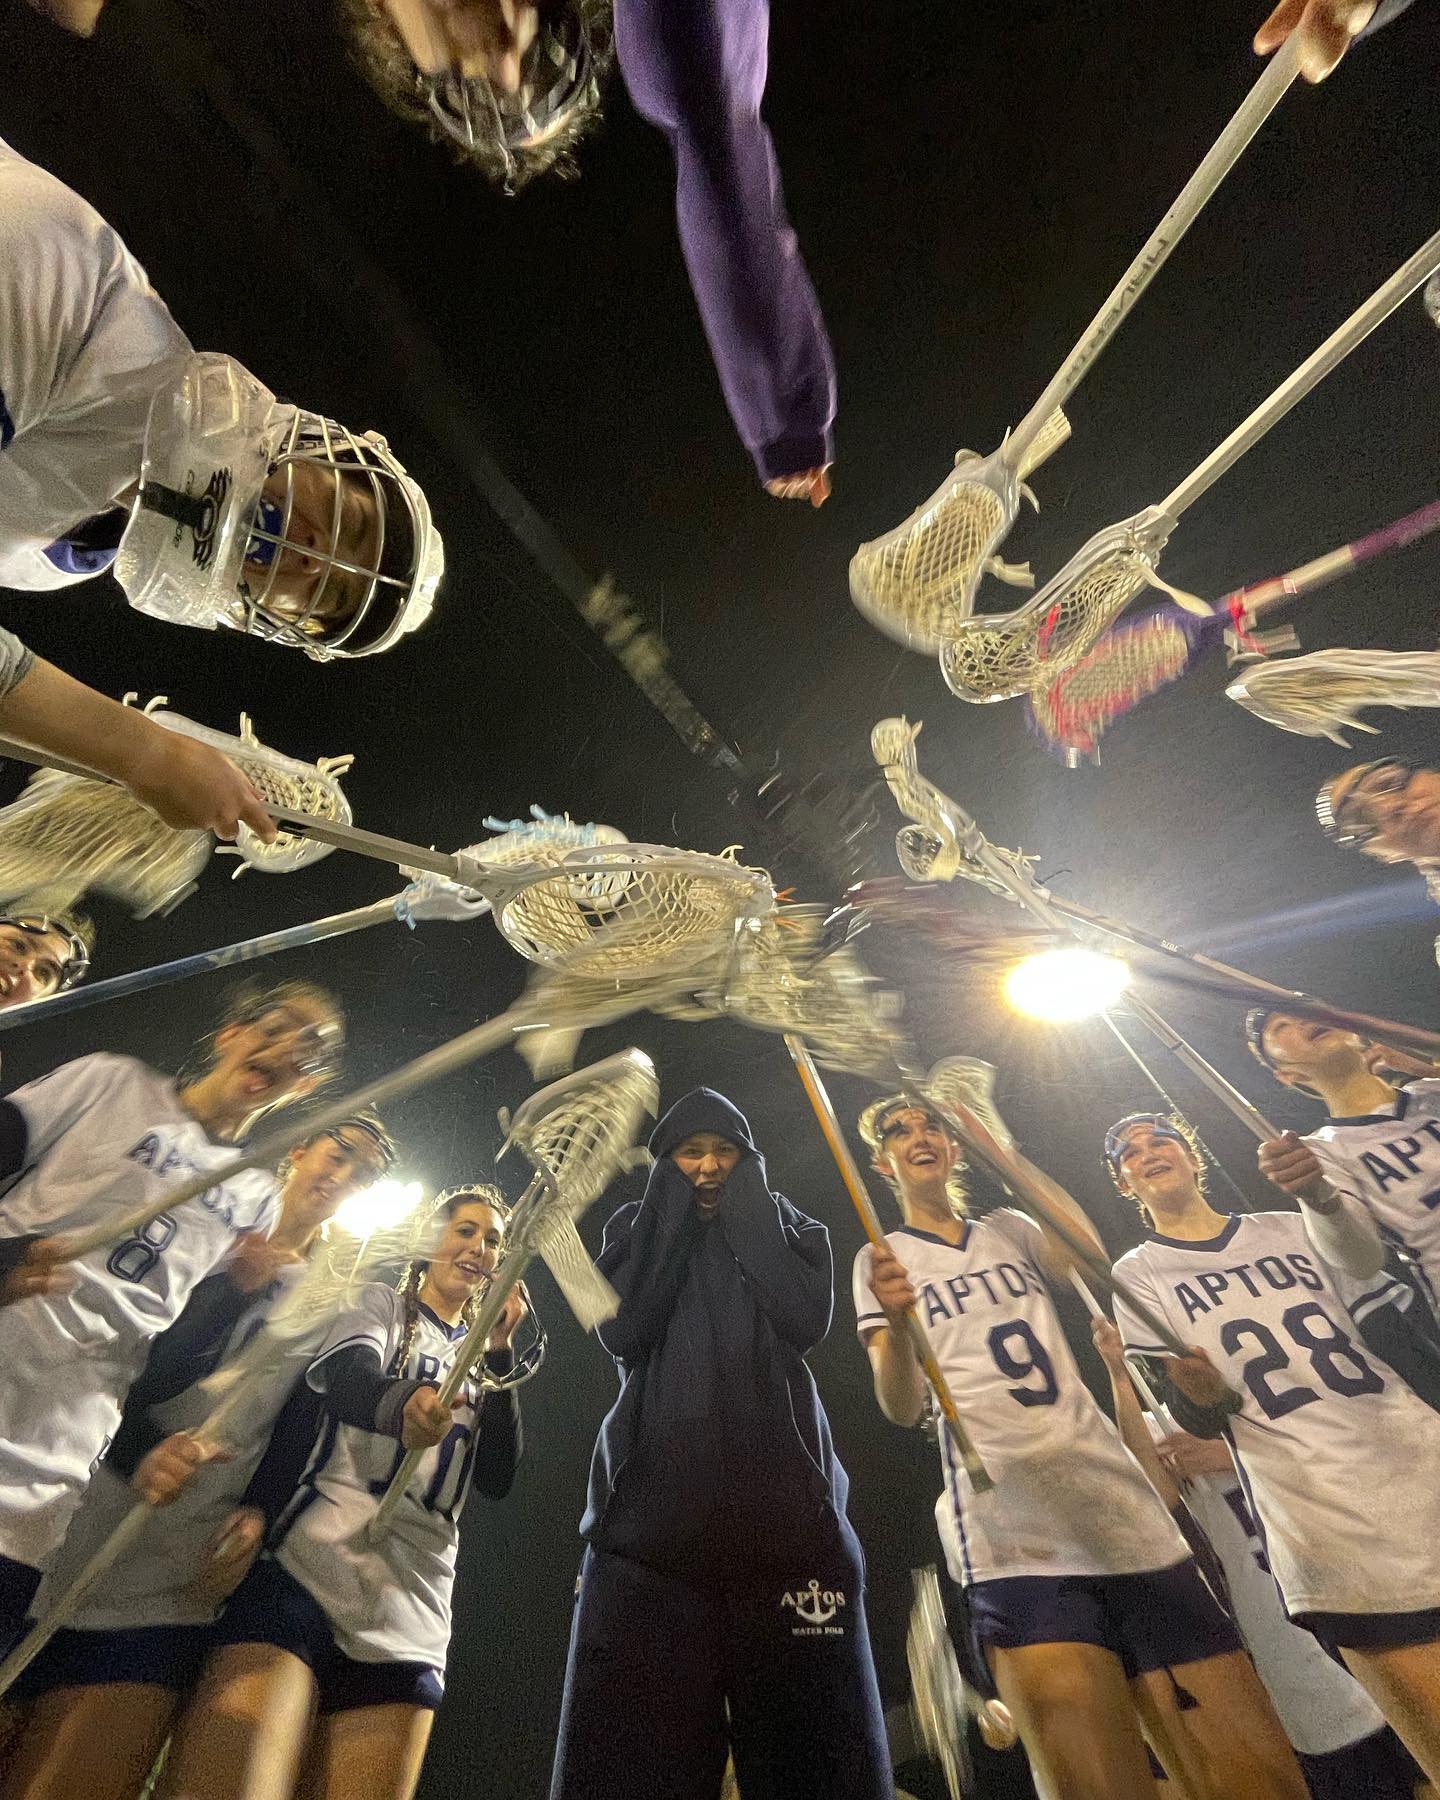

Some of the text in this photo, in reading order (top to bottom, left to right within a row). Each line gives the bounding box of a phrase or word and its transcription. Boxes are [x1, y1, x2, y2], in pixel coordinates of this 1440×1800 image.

[106, 1212, 177, 1283] 8
[922, 1262, 1045, 1328] APTOS
[1174, 1253, 1323, 1325] APTOS
[987, 1318, 1058, 1407] 9
[1220, 1301, 1385, 1421] 28
[781, 1591, 846, 1606] APTOS
